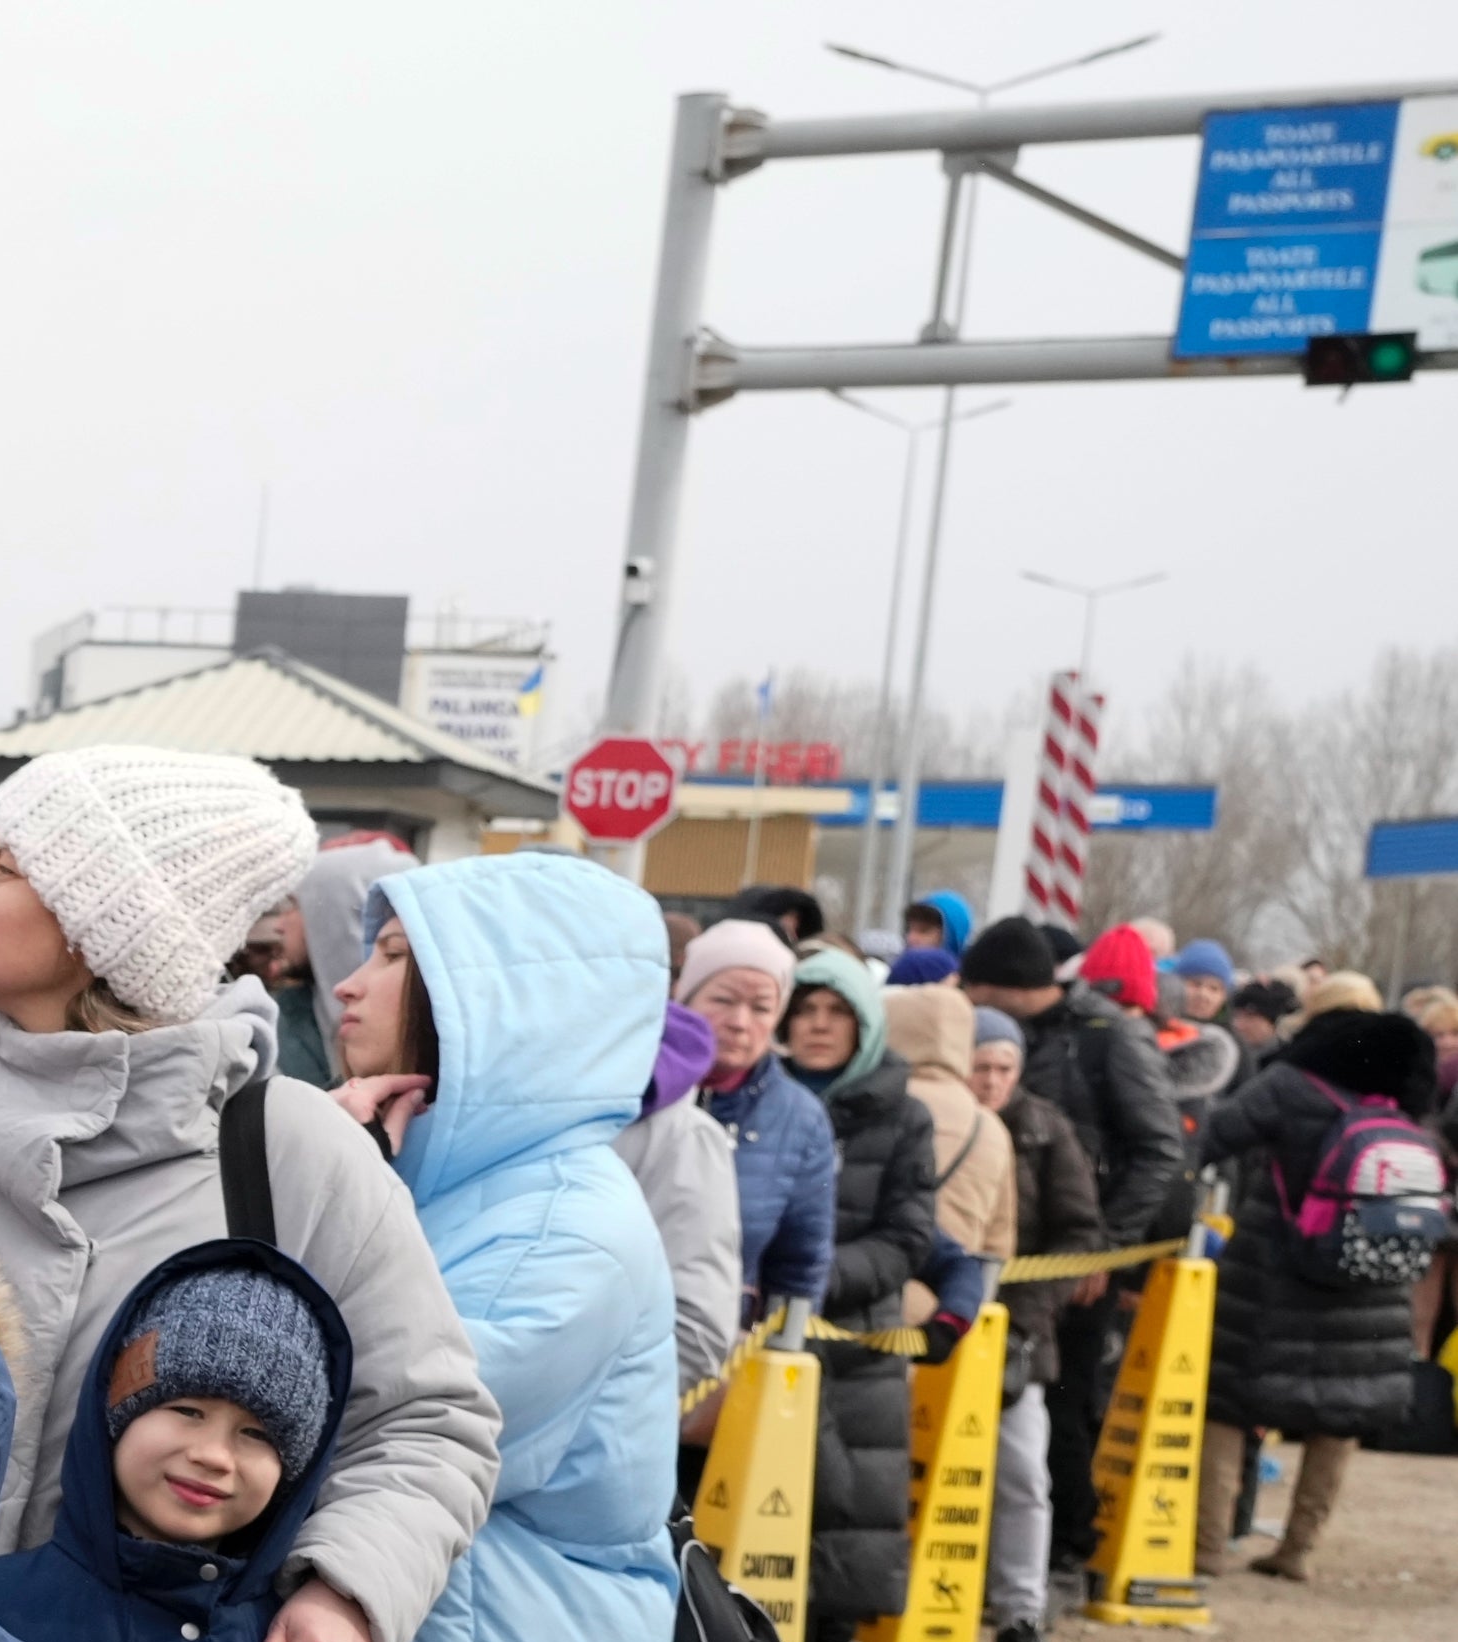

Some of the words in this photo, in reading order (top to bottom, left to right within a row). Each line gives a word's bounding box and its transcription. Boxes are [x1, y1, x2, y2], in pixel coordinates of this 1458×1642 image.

[1271, 168, 1314, 190] ALL
[1228, 189, 1354, 215] PASSPORTS
[1253, 292, 1296, 314] ALL
[1209, 314, 1335, 341] PASSPORTS
[571, 767, 668, 811] STOP
[741, 1553, 795, 1580] CAUTION
